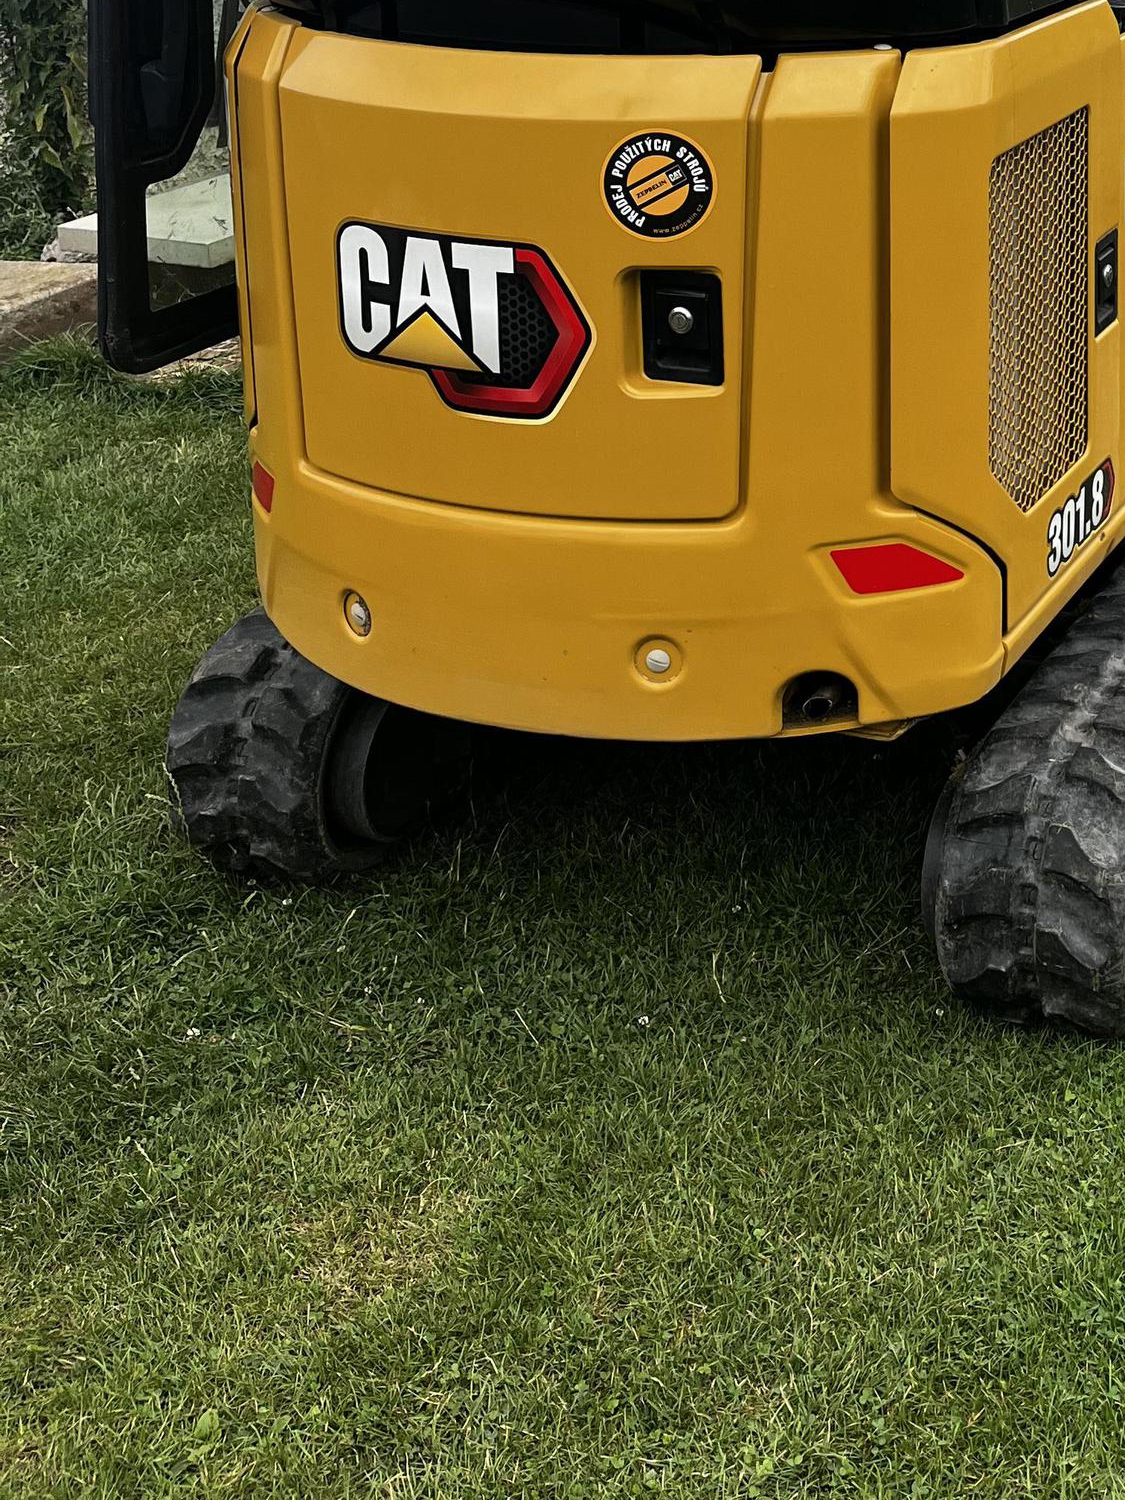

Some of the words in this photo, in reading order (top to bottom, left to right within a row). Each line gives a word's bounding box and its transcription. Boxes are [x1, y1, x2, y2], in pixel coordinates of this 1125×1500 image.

[611, 136, 672, 178] POUŽITÝCH
[610, 184, 646, 228] PRODEJ
[636, 179, 667, 199] ZEPPELIN
[668, 169, 683, 182] CAT
[339, 224, 515, 374] CAT
[1048, 469, 1104, 573] 301.8
